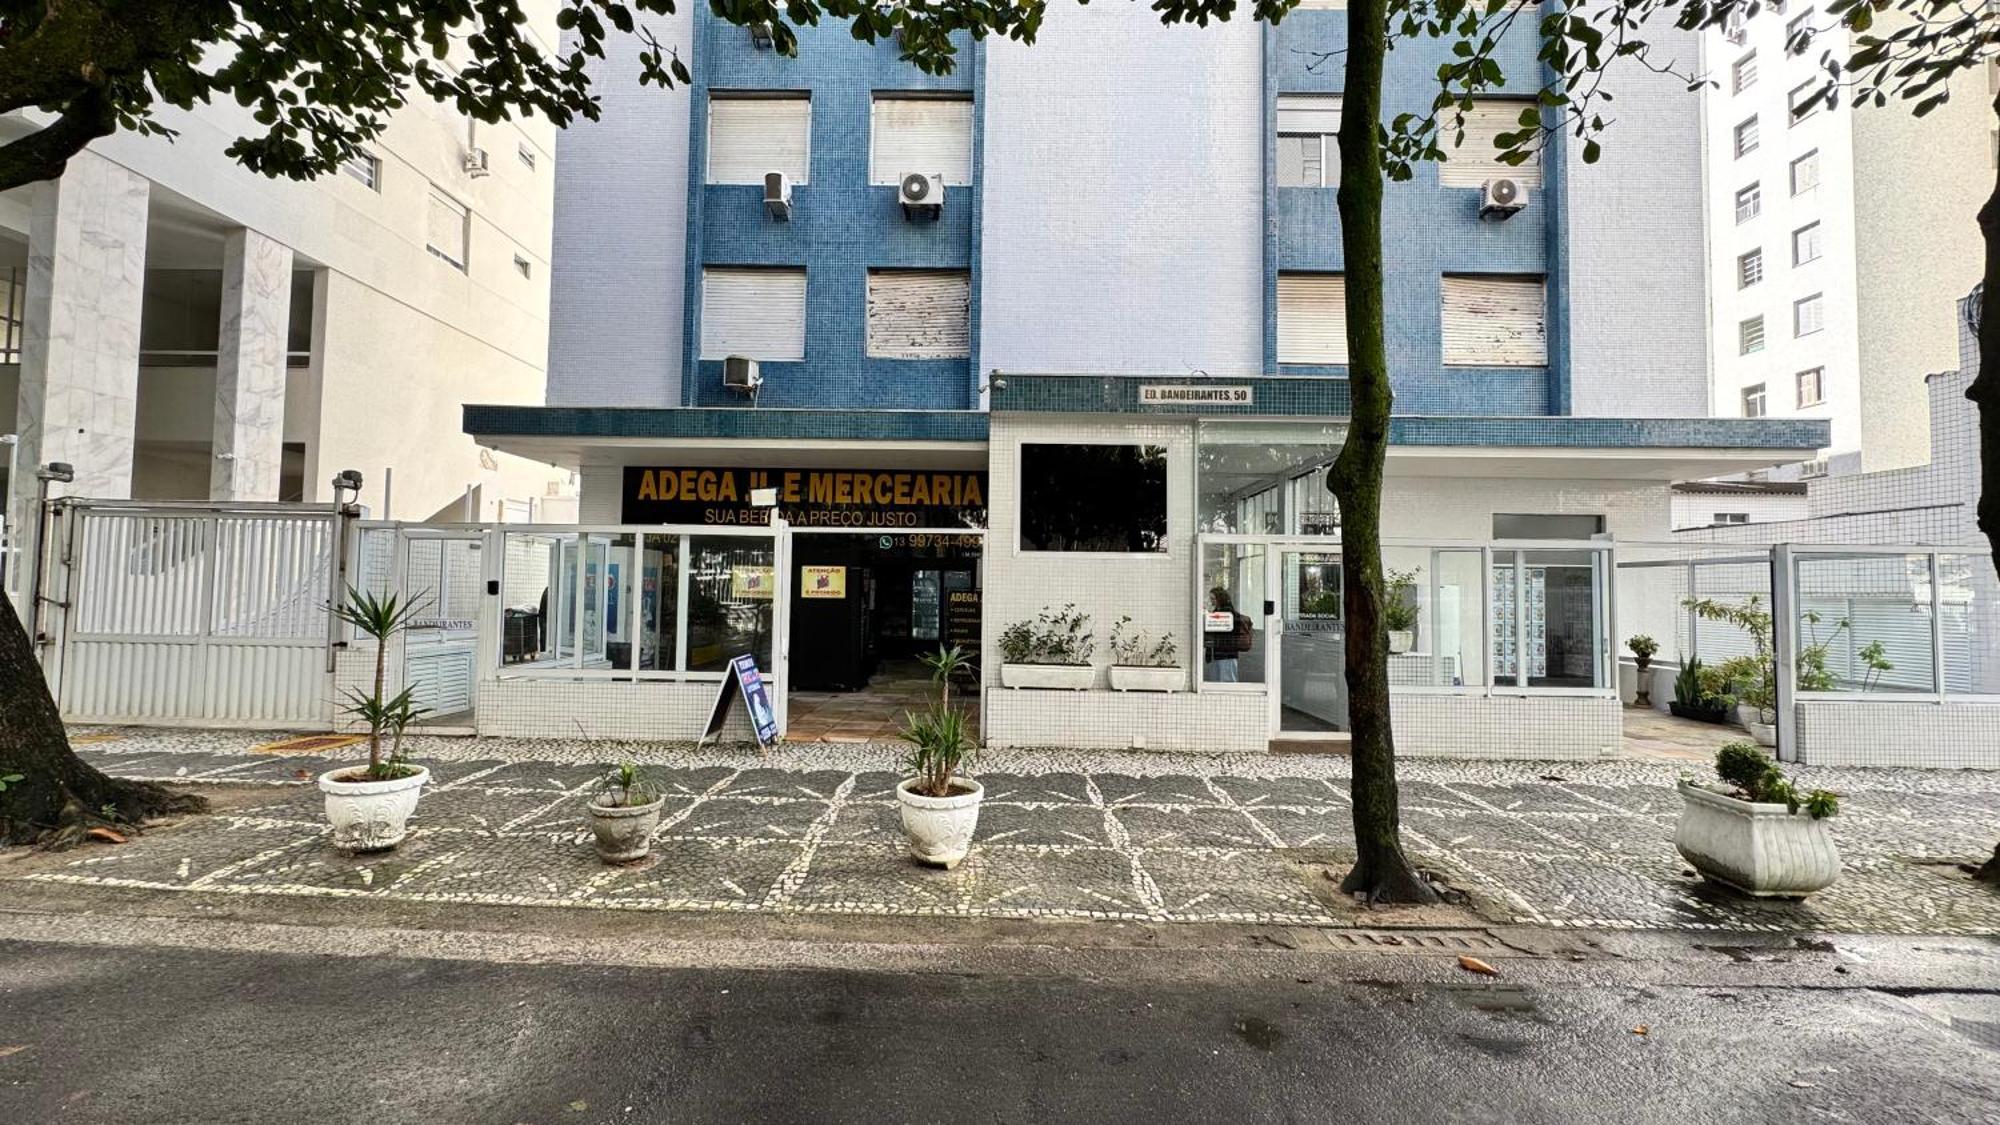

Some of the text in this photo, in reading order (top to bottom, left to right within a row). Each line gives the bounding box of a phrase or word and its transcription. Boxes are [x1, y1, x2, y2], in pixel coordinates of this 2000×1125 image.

[1144, 389, 1159, 399] ED.
[1234, 390, 1247, 400] 50
[638, 470, 738, 501] ADEGA
[783, 472, 800, 502] E
[808, 472, 983, 506] MERCEARIA
[704, 508, 917, 527] SUA BEBA A PREÇO JUSTO
[950, 592, 978, 602] ADEGA
